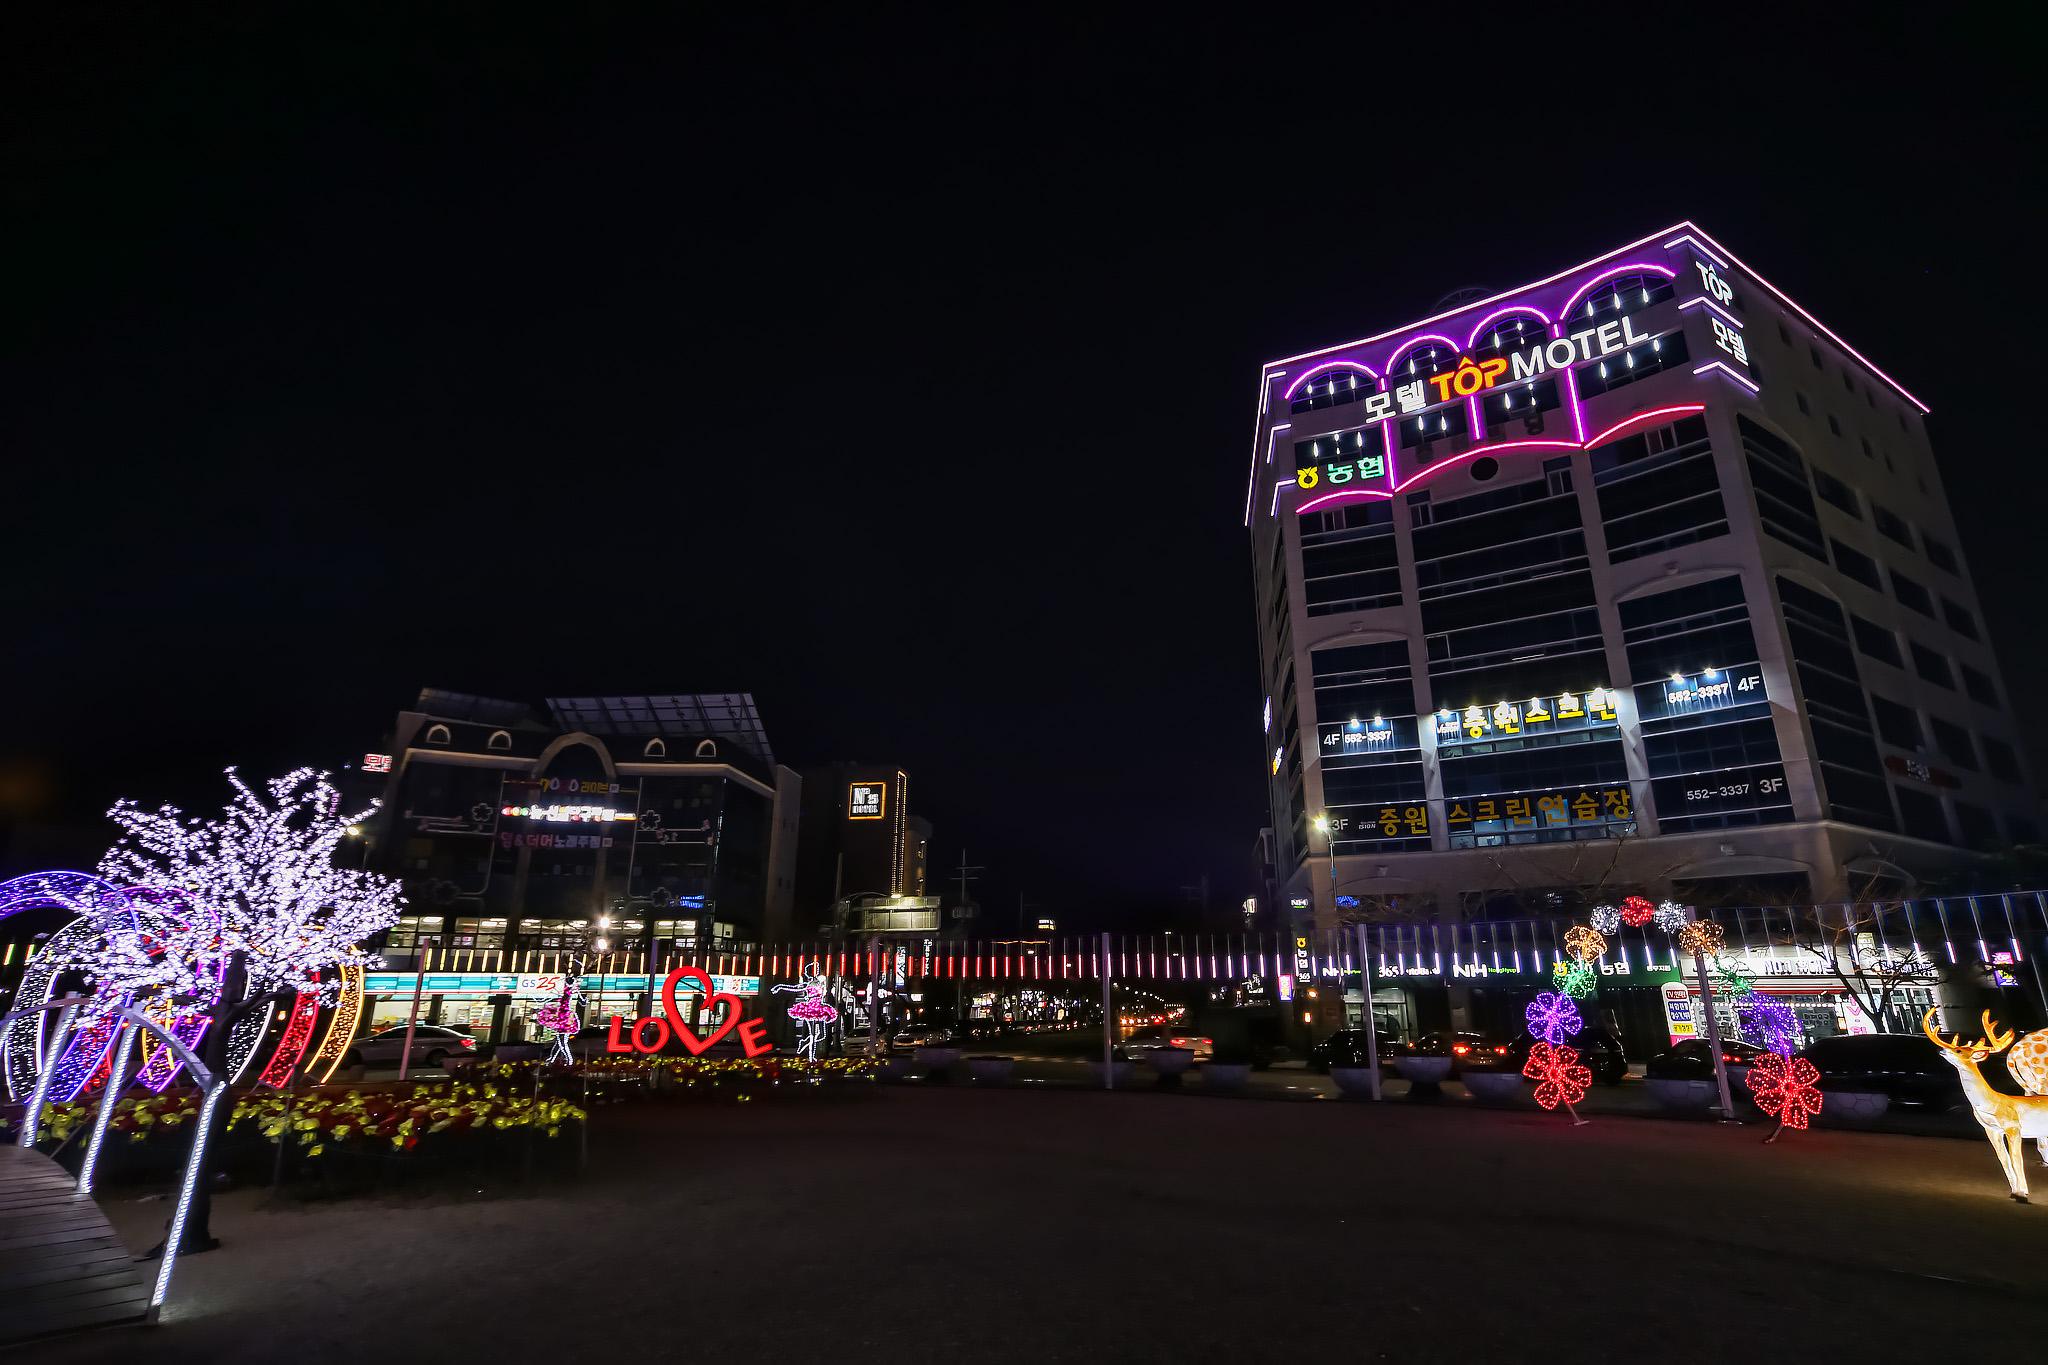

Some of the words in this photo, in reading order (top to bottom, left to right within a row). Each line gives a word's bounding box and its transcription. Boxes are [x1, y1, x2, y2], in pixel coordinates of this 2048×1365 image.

[1711, 317, 1749, 367] 모텔
[1365, 379, 1427, 424] 모텔
[1511, 315, 1650, 381] MOTEL
[1327, 455, 1385, 485] 농협
[1668, 683, 1729, 704] 552-3337
[1737, 675, 1760, 691] 4F
[1323, 733, 1341, 746] 4F
[1344, 730, 1392, 744] 552-3337
[1686, 784, 1750, 801] 552-3337
[1759, 777, 1783, 794] 3F
[1331, 818, 1349, 831] 3F
[1452, 963, 1488, 978] NH
